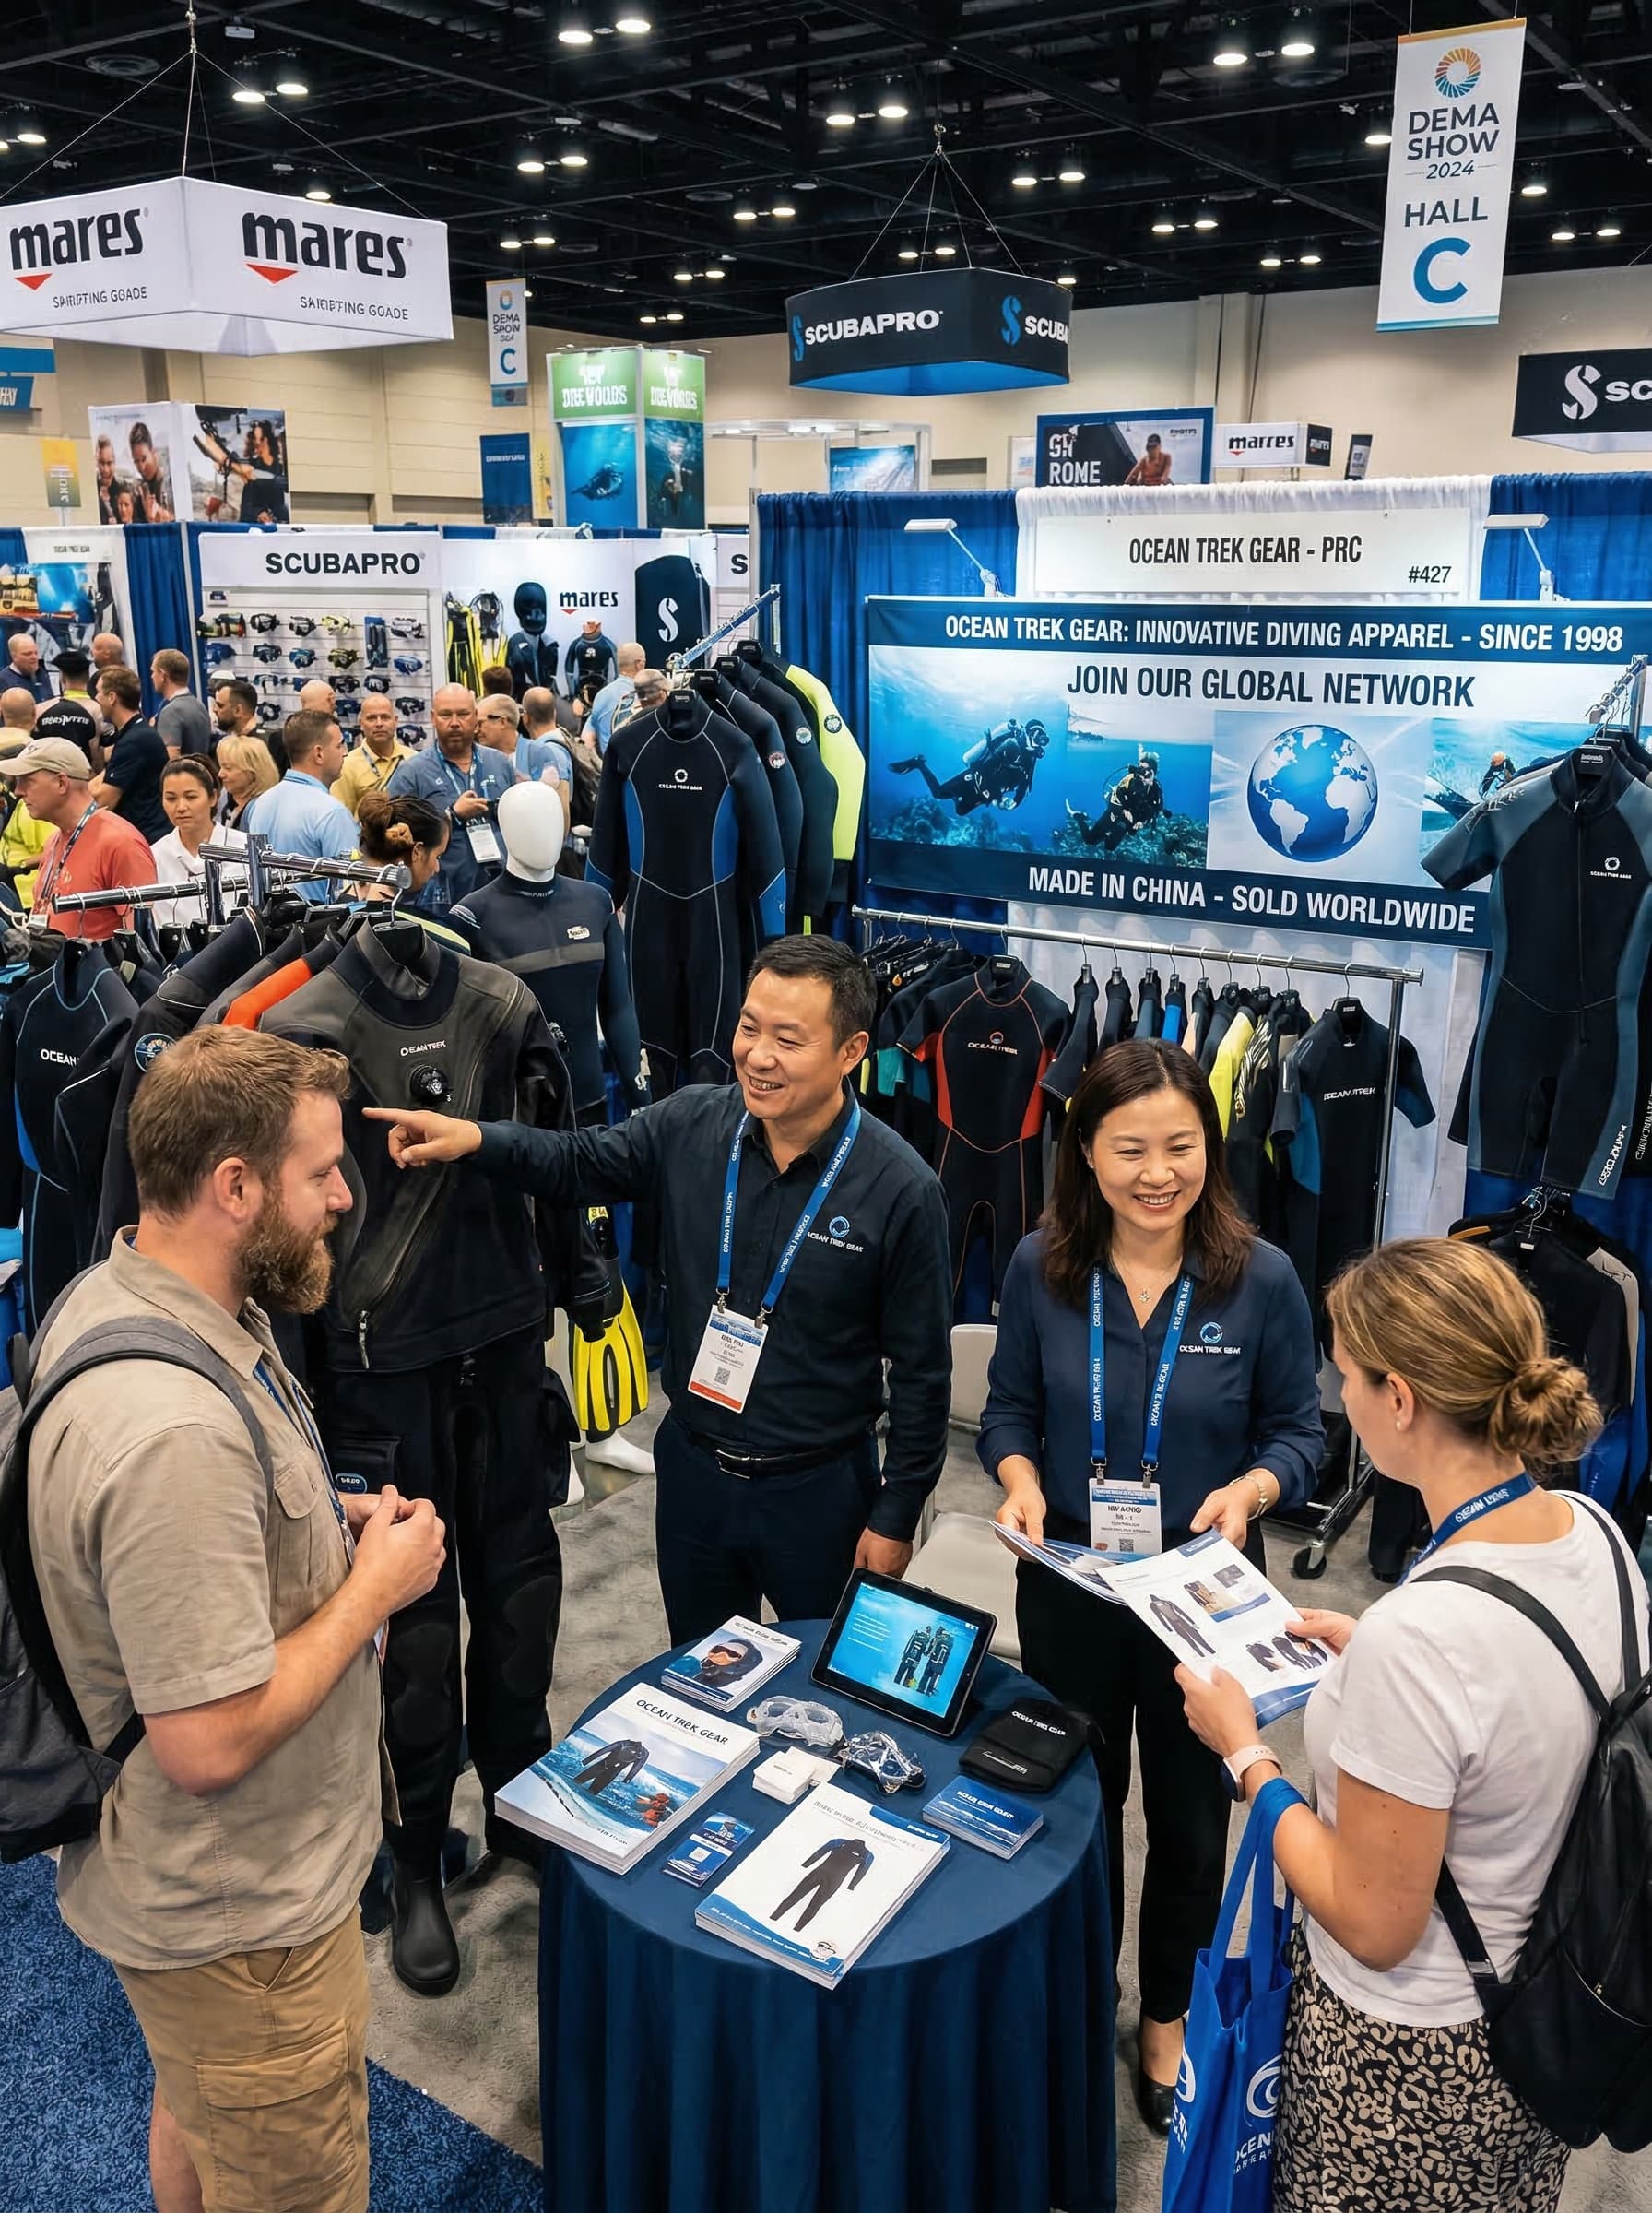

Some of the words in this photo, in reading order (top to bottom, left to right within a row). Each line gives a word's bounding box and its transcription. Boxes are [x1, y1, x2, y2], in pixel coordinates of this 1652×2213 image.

[1409, 102, 1500, 135] DEMA
[1407, 129, 1501, 160] SHOW
[1426, 160, 1475, 180] 2024
[1404, 196, 1488, 228] HALL
[9, 208, 144, 271] mares
[242, 212, 407, 279] mares
[1412, 237, 1471, 304] C
[805, 309, 940, 345] SCUBAPRO
[501, 348, 516, 375] C
[266, 552, 420, 574] SCUBAPRO
[1129, 538, 1189, 564] OCEAN
[1197, 538, 1245, 563] TREK
[1250, 537, 1300, 563] GEAR
[1322, 535, 1363, 562] PRC
[1408, 566, 1452, 584] #427
[560, 591, 619, 608] mares
[946, 615, 1009, 640] OCEAN
[1013, 617, 1065, 641] TREK
[1069, 618, 1128, 643] GEAR:
[1135, 620, 1258, 645] INNOVATIVE
[1266, 621, 1341, 647] DIVING
[1348, 623, 1454, 649] APPAREL
[1479, 624, 1552, 651] SINCE
[1562, 626, 1623, 652] 1998
[1067, 665, 1127, 695] JOIN
[1137, 667, 1192, 698] OUR
[1201, 669, 1313, 704] GLOBAL
[1323, 672, 1476, 707] NETWORK
[1028, 866, 1094, 897] MADE
[1102, 872, 1125, 899] IN
[1132, 876, 1206, 908] CHINA
[1232, 884, 1298, 916] SOLD
[1307, 892, 1475, 934] WORLDWIDE
[636, 1699, 673, 1721] OCEAN
[700, 1729, 729, 1745] GEAR
